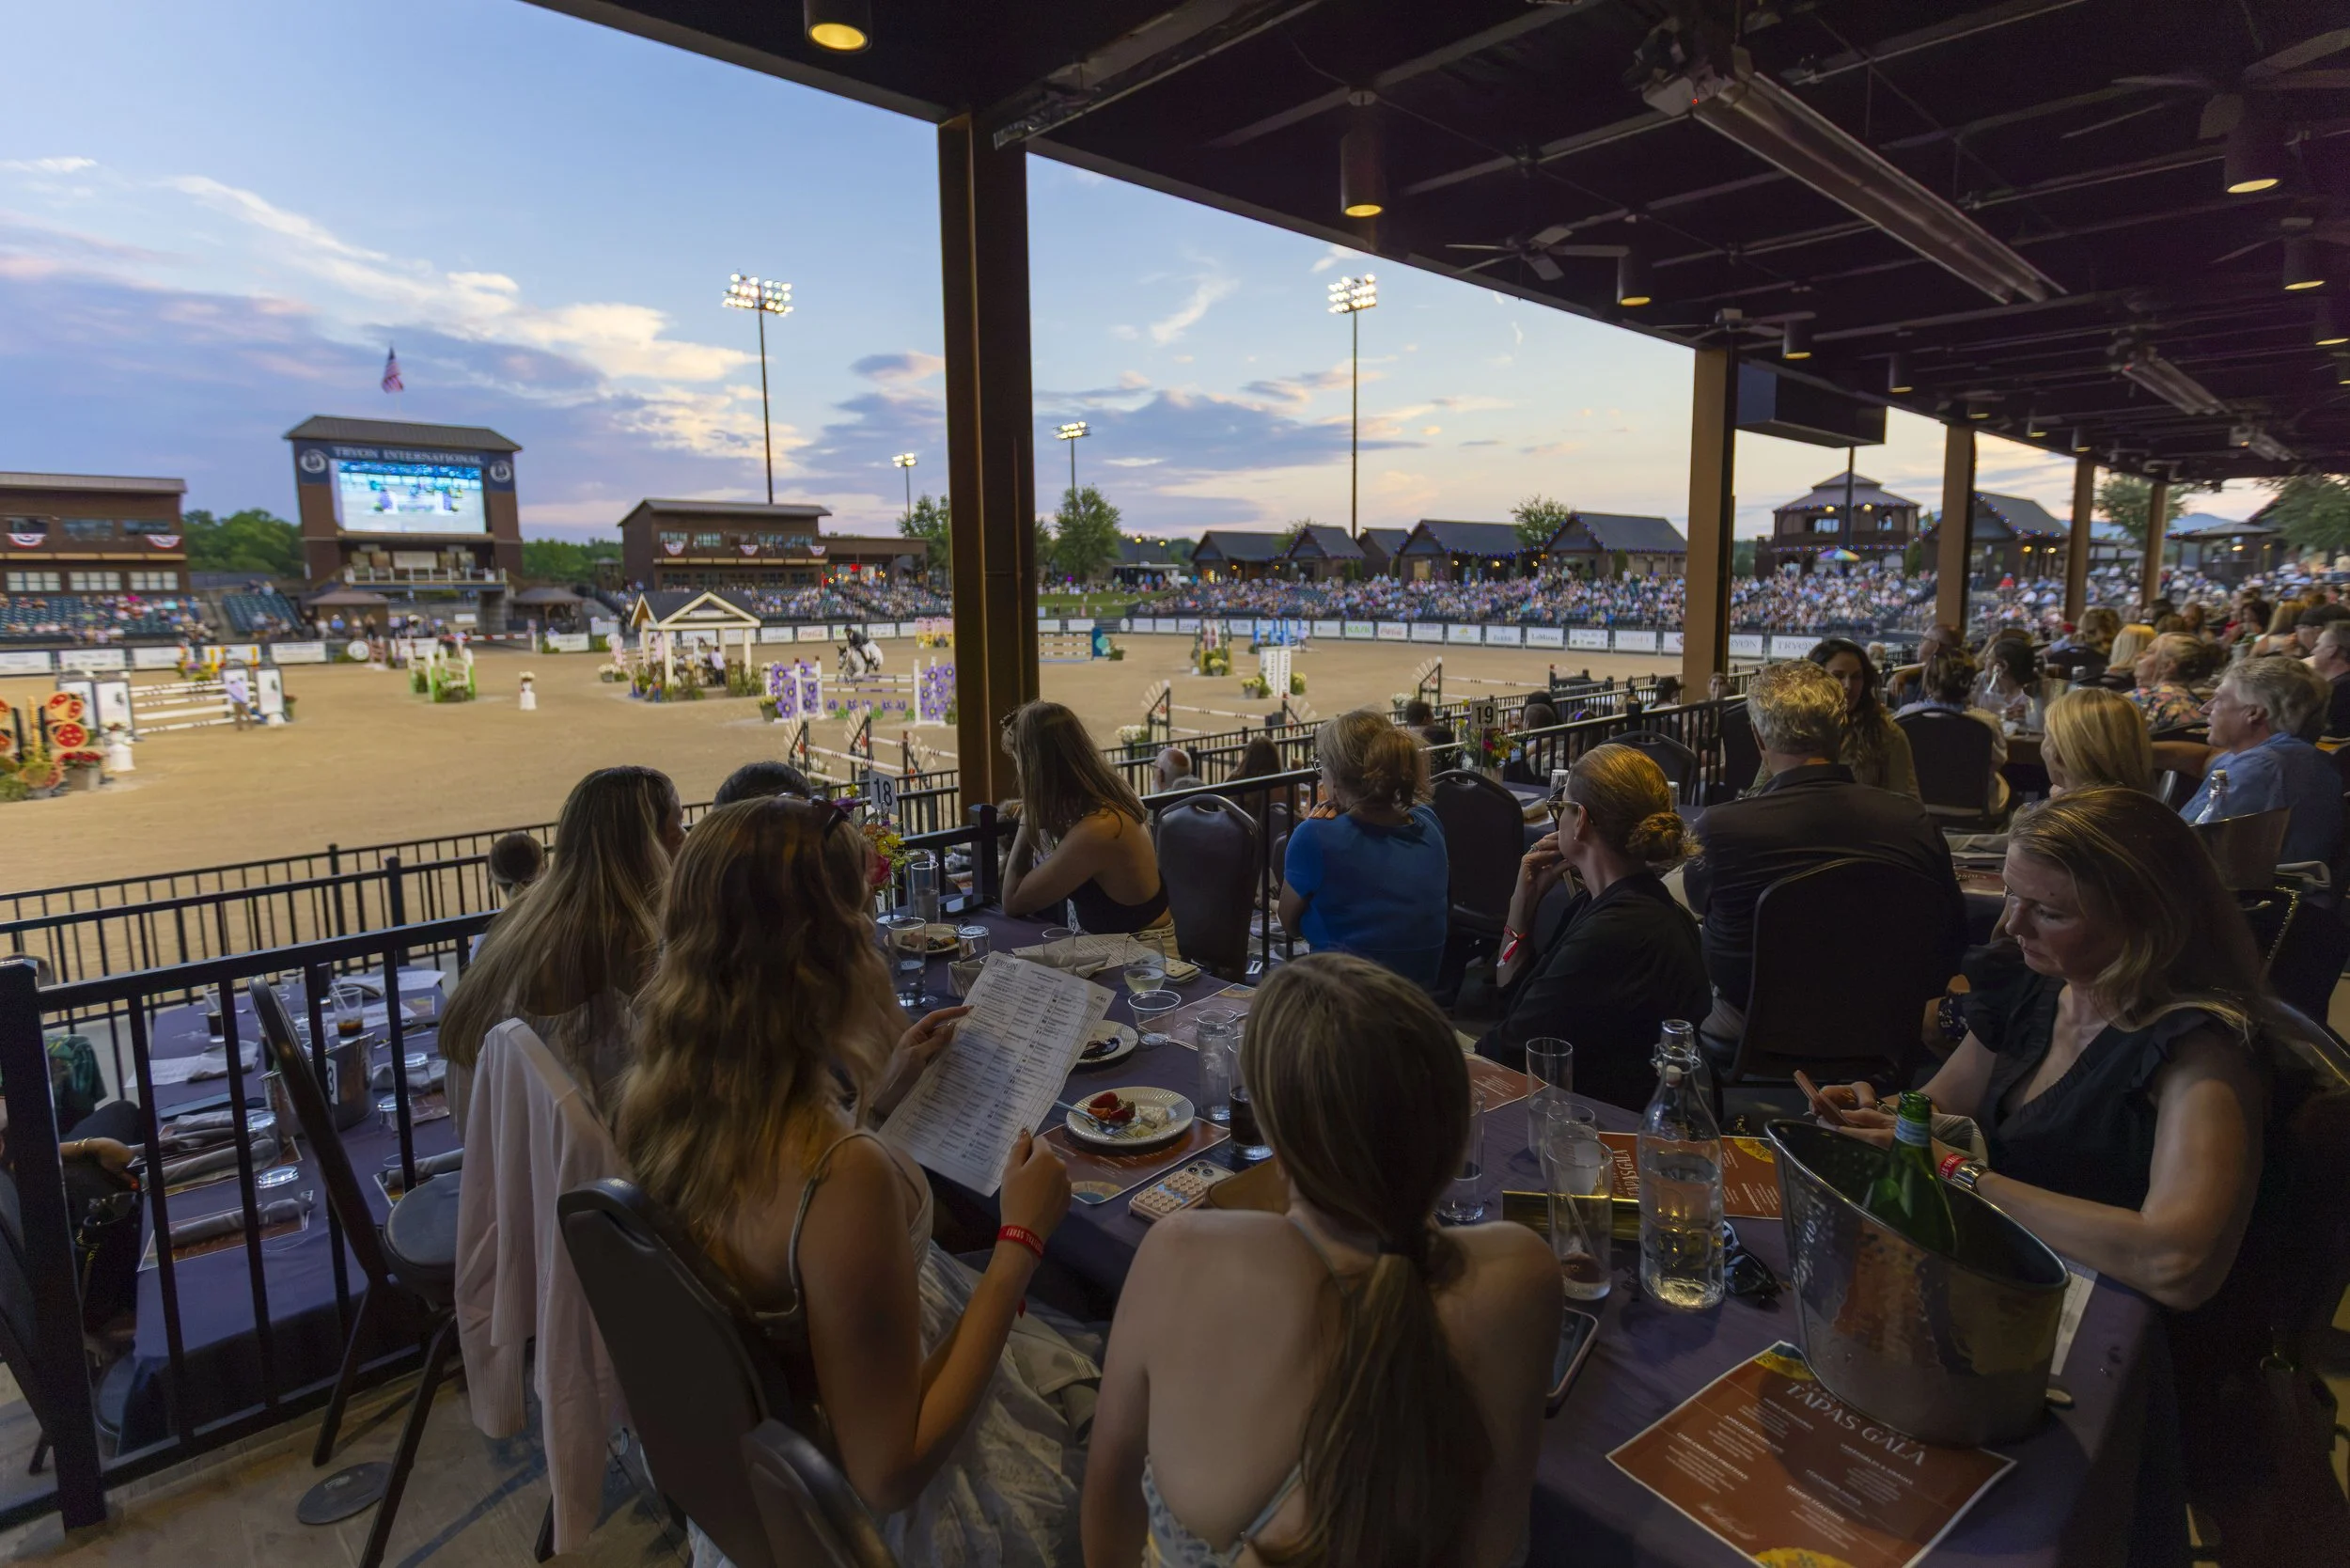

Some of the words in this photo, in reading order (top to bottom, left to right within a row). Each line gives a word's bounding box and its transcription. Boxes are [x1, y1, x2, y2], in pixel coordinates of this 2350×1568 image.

[333, 447, 379, 459] TRYON
[384, 448, 482, 464] INTERNATIONAL
[1476, 705, 1494, 724] 19
[873, 777, 893, 807] 18
[1784, 1382, 1860, 1430] TAPAS
[1861, 1427, 1927, 1466] GALA
